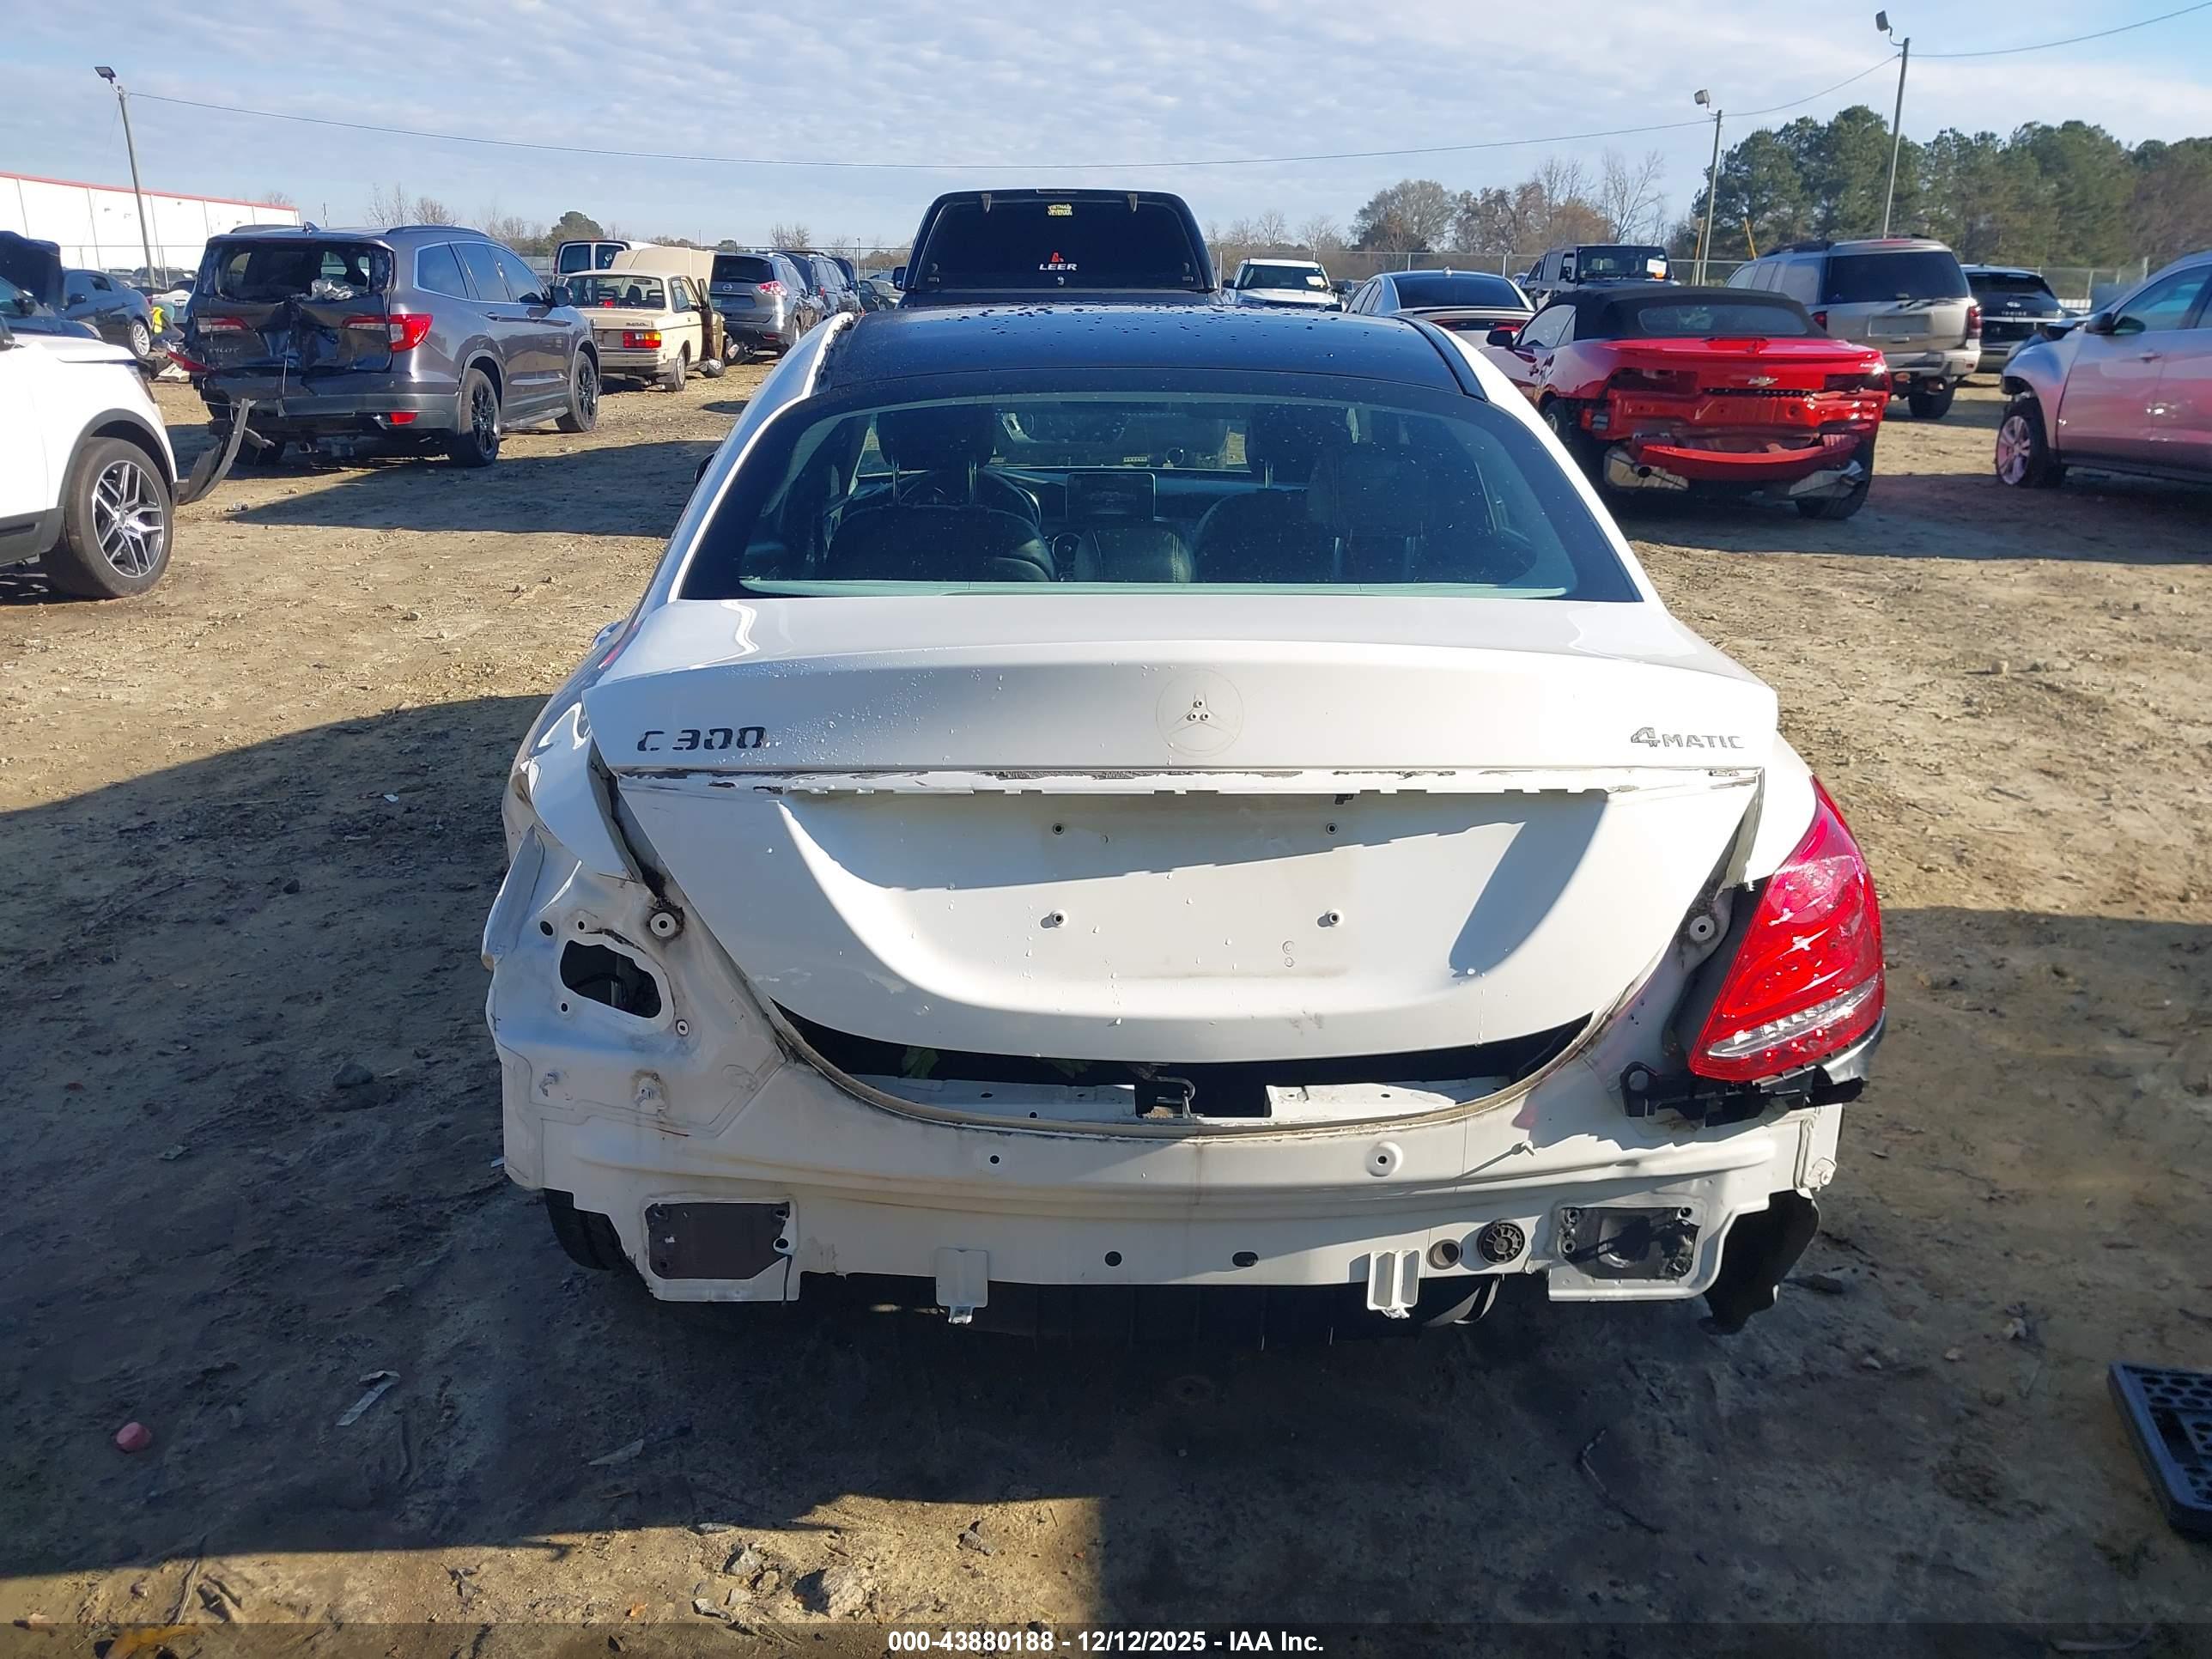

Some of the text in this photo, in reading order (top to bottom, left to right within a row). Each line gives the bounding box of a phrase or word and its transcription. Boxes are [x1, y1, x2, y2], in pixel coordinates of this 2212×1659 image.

[637, 726, 766, 751] C 300
[1630, 726, 1745, 749] 4MATIC
